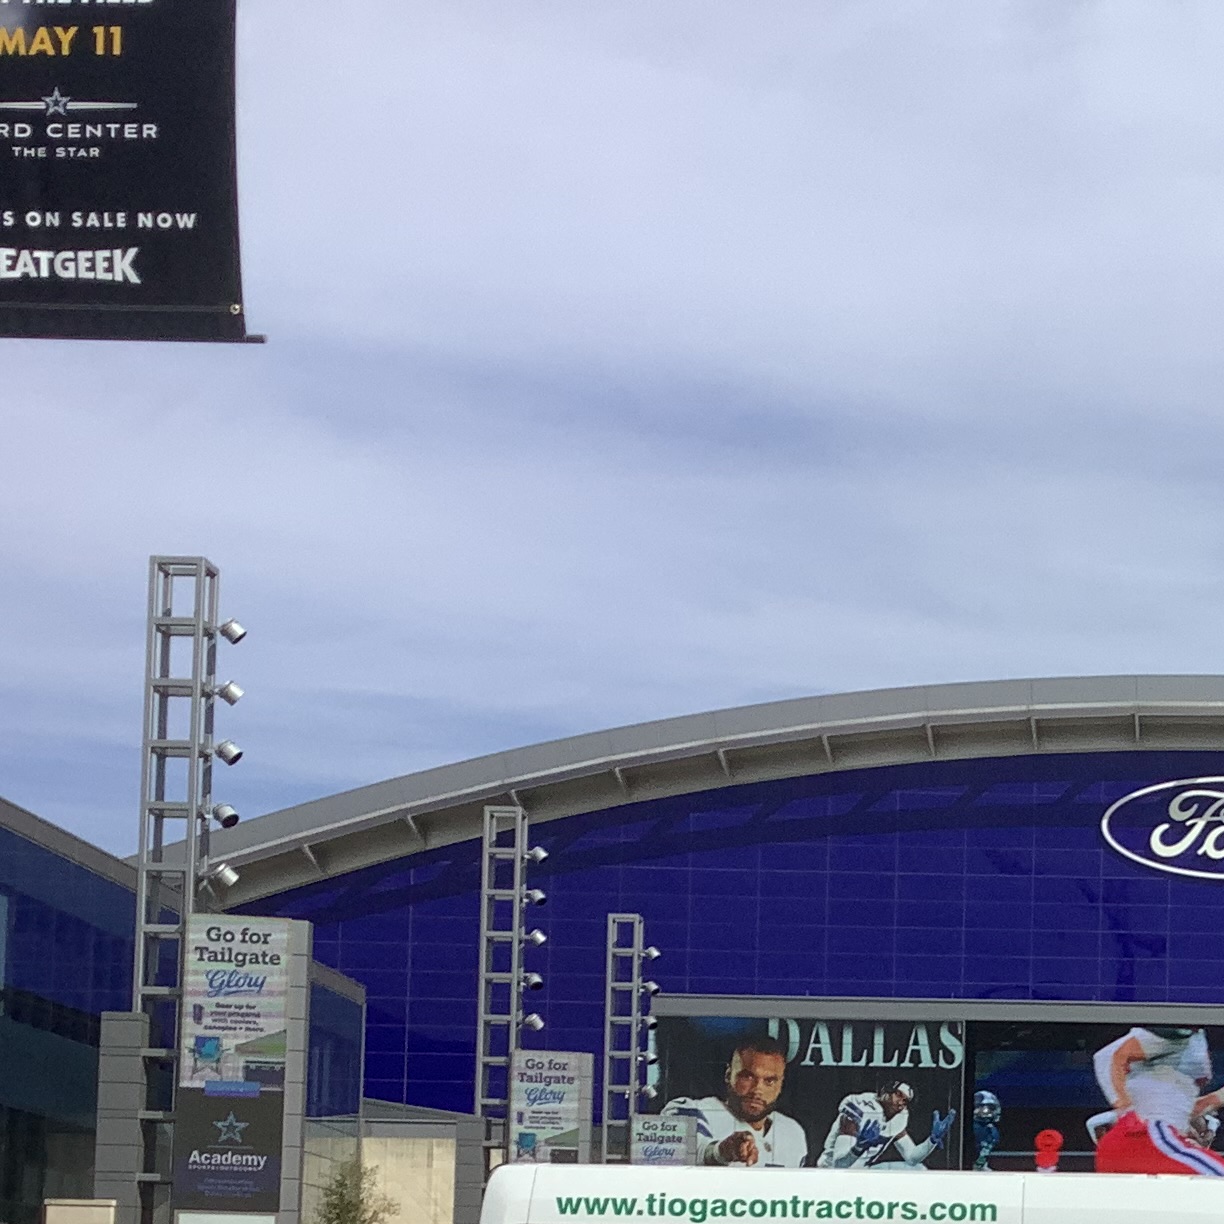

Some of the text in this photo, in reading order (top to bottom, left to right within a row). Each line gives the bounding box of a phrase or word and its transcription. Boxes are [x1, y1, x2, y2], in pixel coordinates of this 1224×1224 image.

[0, 26, 122, 56] MAY 11
[46, 123, 158, 139] CENTER
[12, 146, 101, 158] THE STAR
[25, 211, 60, 227] ON
[71, 212, 126, 228] SALE
[137, 212, 197, 229] NOW
[206, 926, 272, 944] Go for
[195, 946, 281, 967] Tailgate
[205, 969, 267, 998] Glory
[768, 1017, 963, 1069] DALLAS
[525, 1058, 569, 1071] Go for
[518, 1072, 575, 1085] Tailgate
[524, 1085, 566, 1106] Glory
[642, 1120, 678, 1132] Go for
[636, 1132, 683, 1144] Tailgate
[188, 1149, 268, 1170] Academy
[556, 1193, 998, 1223] www.tiogacontractors.com
